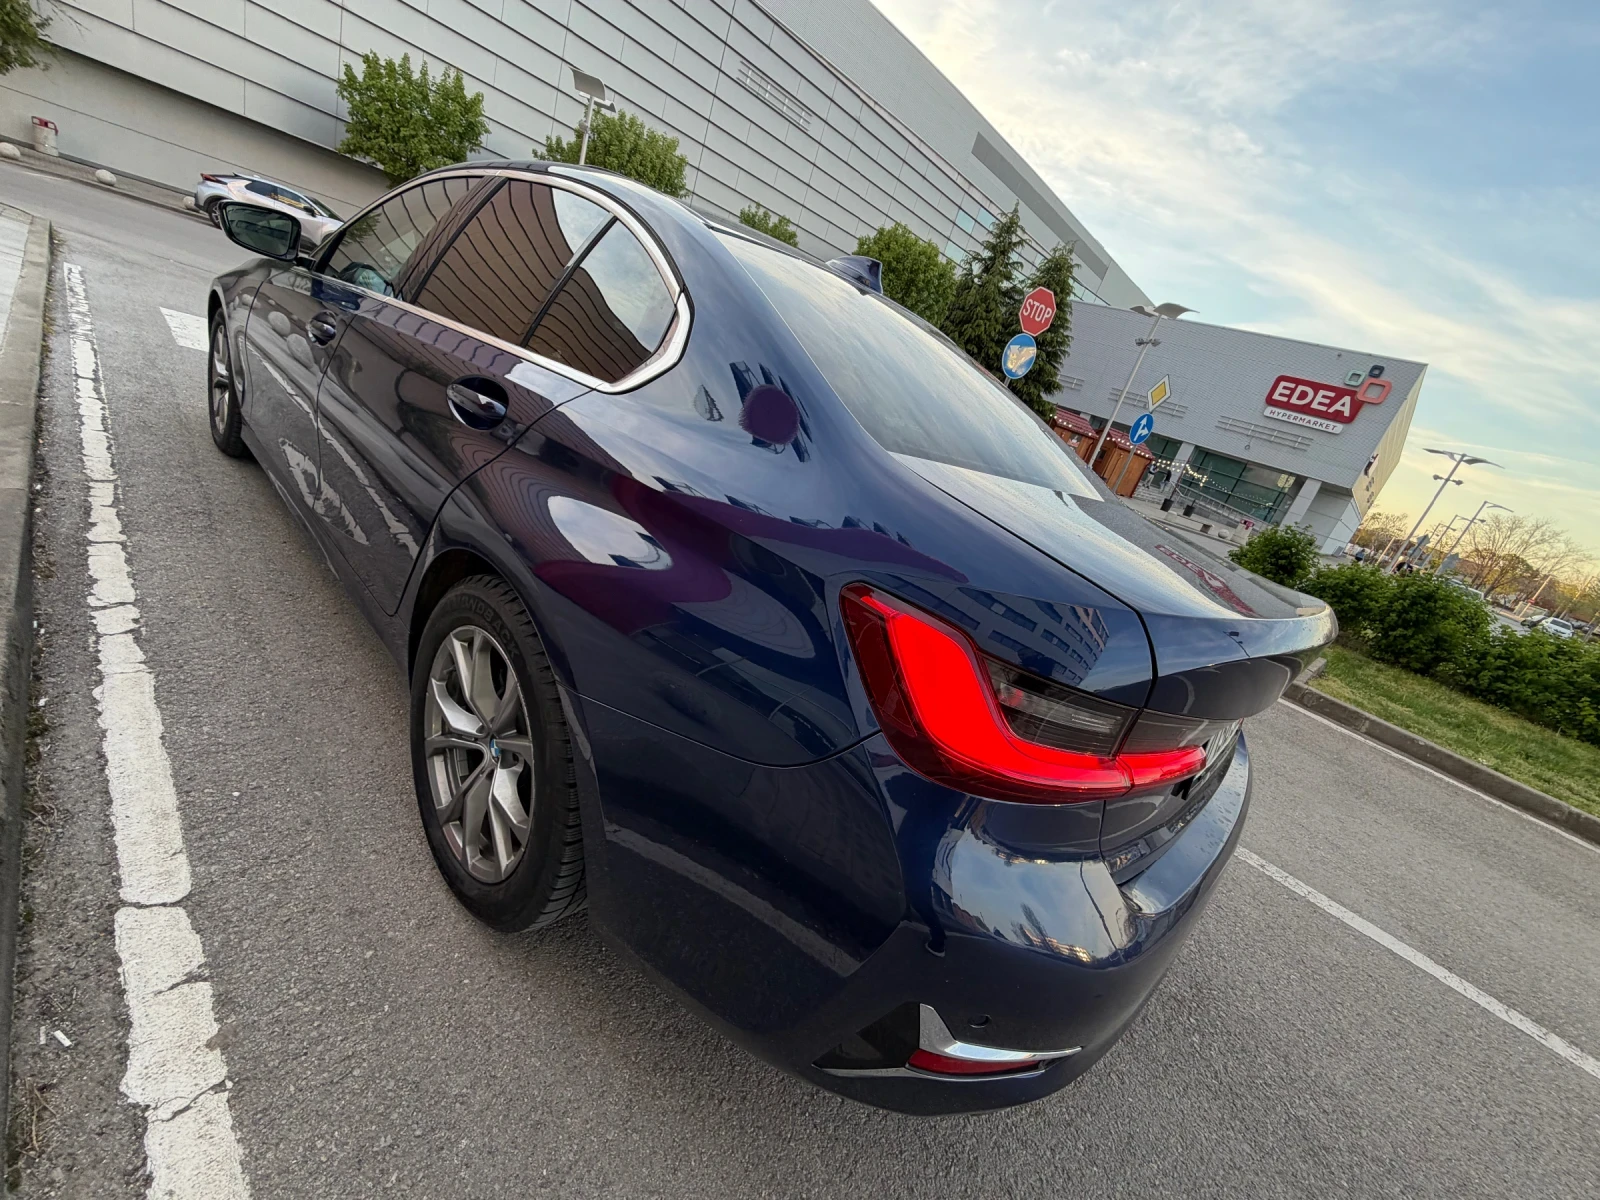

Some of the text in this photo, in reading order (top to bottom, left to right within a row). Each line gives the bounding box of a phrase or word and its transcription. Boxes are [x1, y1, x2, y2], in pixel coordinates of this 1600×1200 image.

[1023, 299, 1052, 324] STOP
[1272, 381, 1351, 417] EDEA
[1269, 409, 1338, 431] HYPERMARKET
